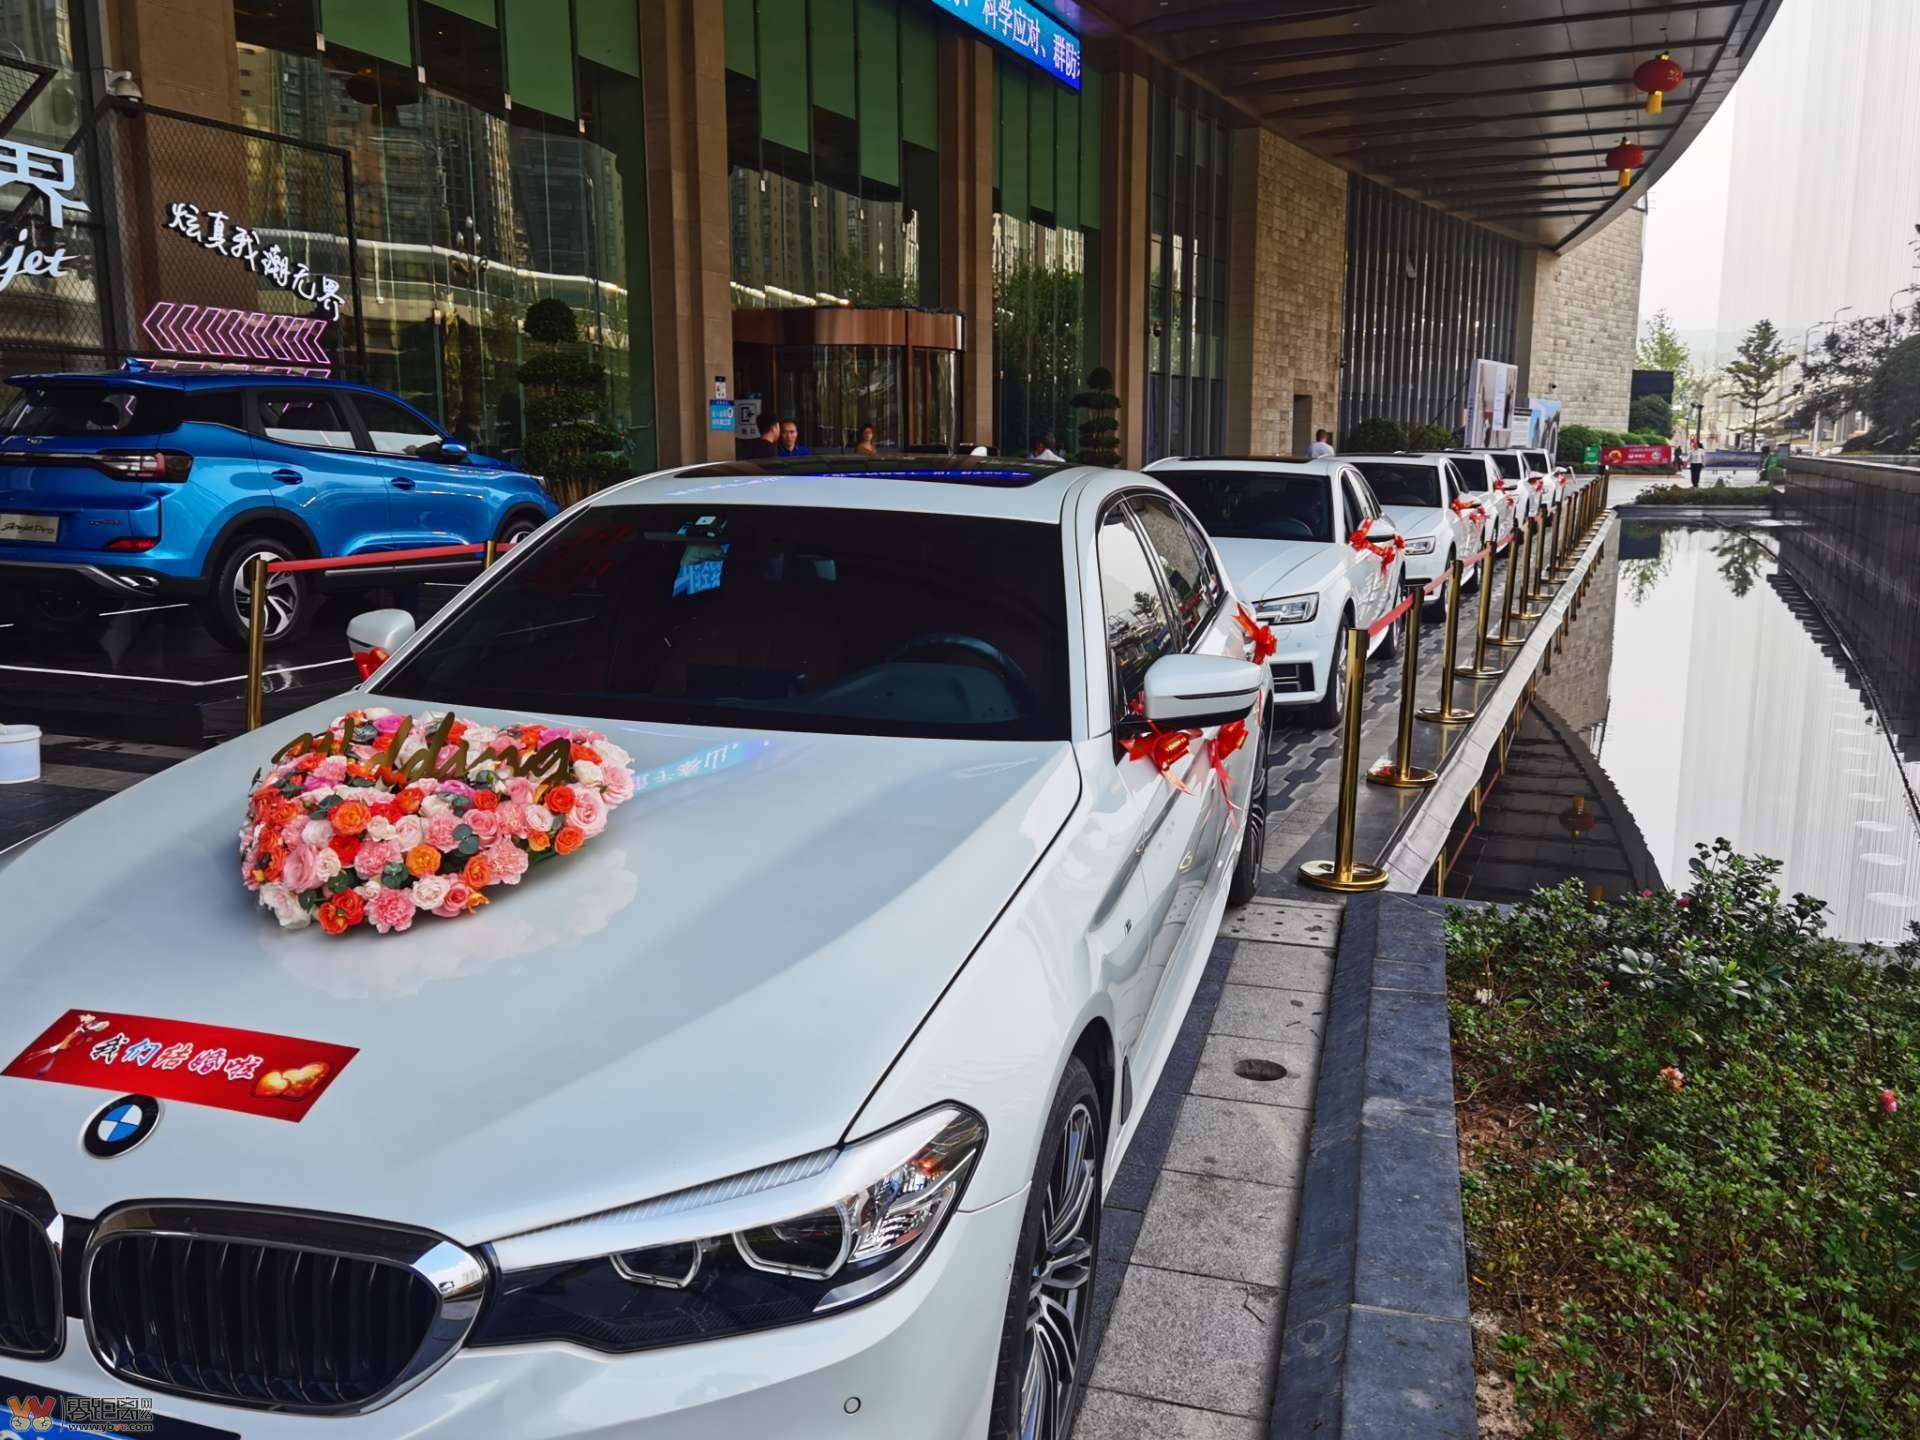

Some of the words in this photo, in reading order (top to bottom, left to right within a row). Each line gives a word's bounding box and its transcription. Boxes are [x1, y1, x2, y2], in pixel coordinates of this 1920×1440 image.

[168, 203, 345, 321] 炫真我潮无界
[90, 1033, 263, 1080] 我们结婚啦
